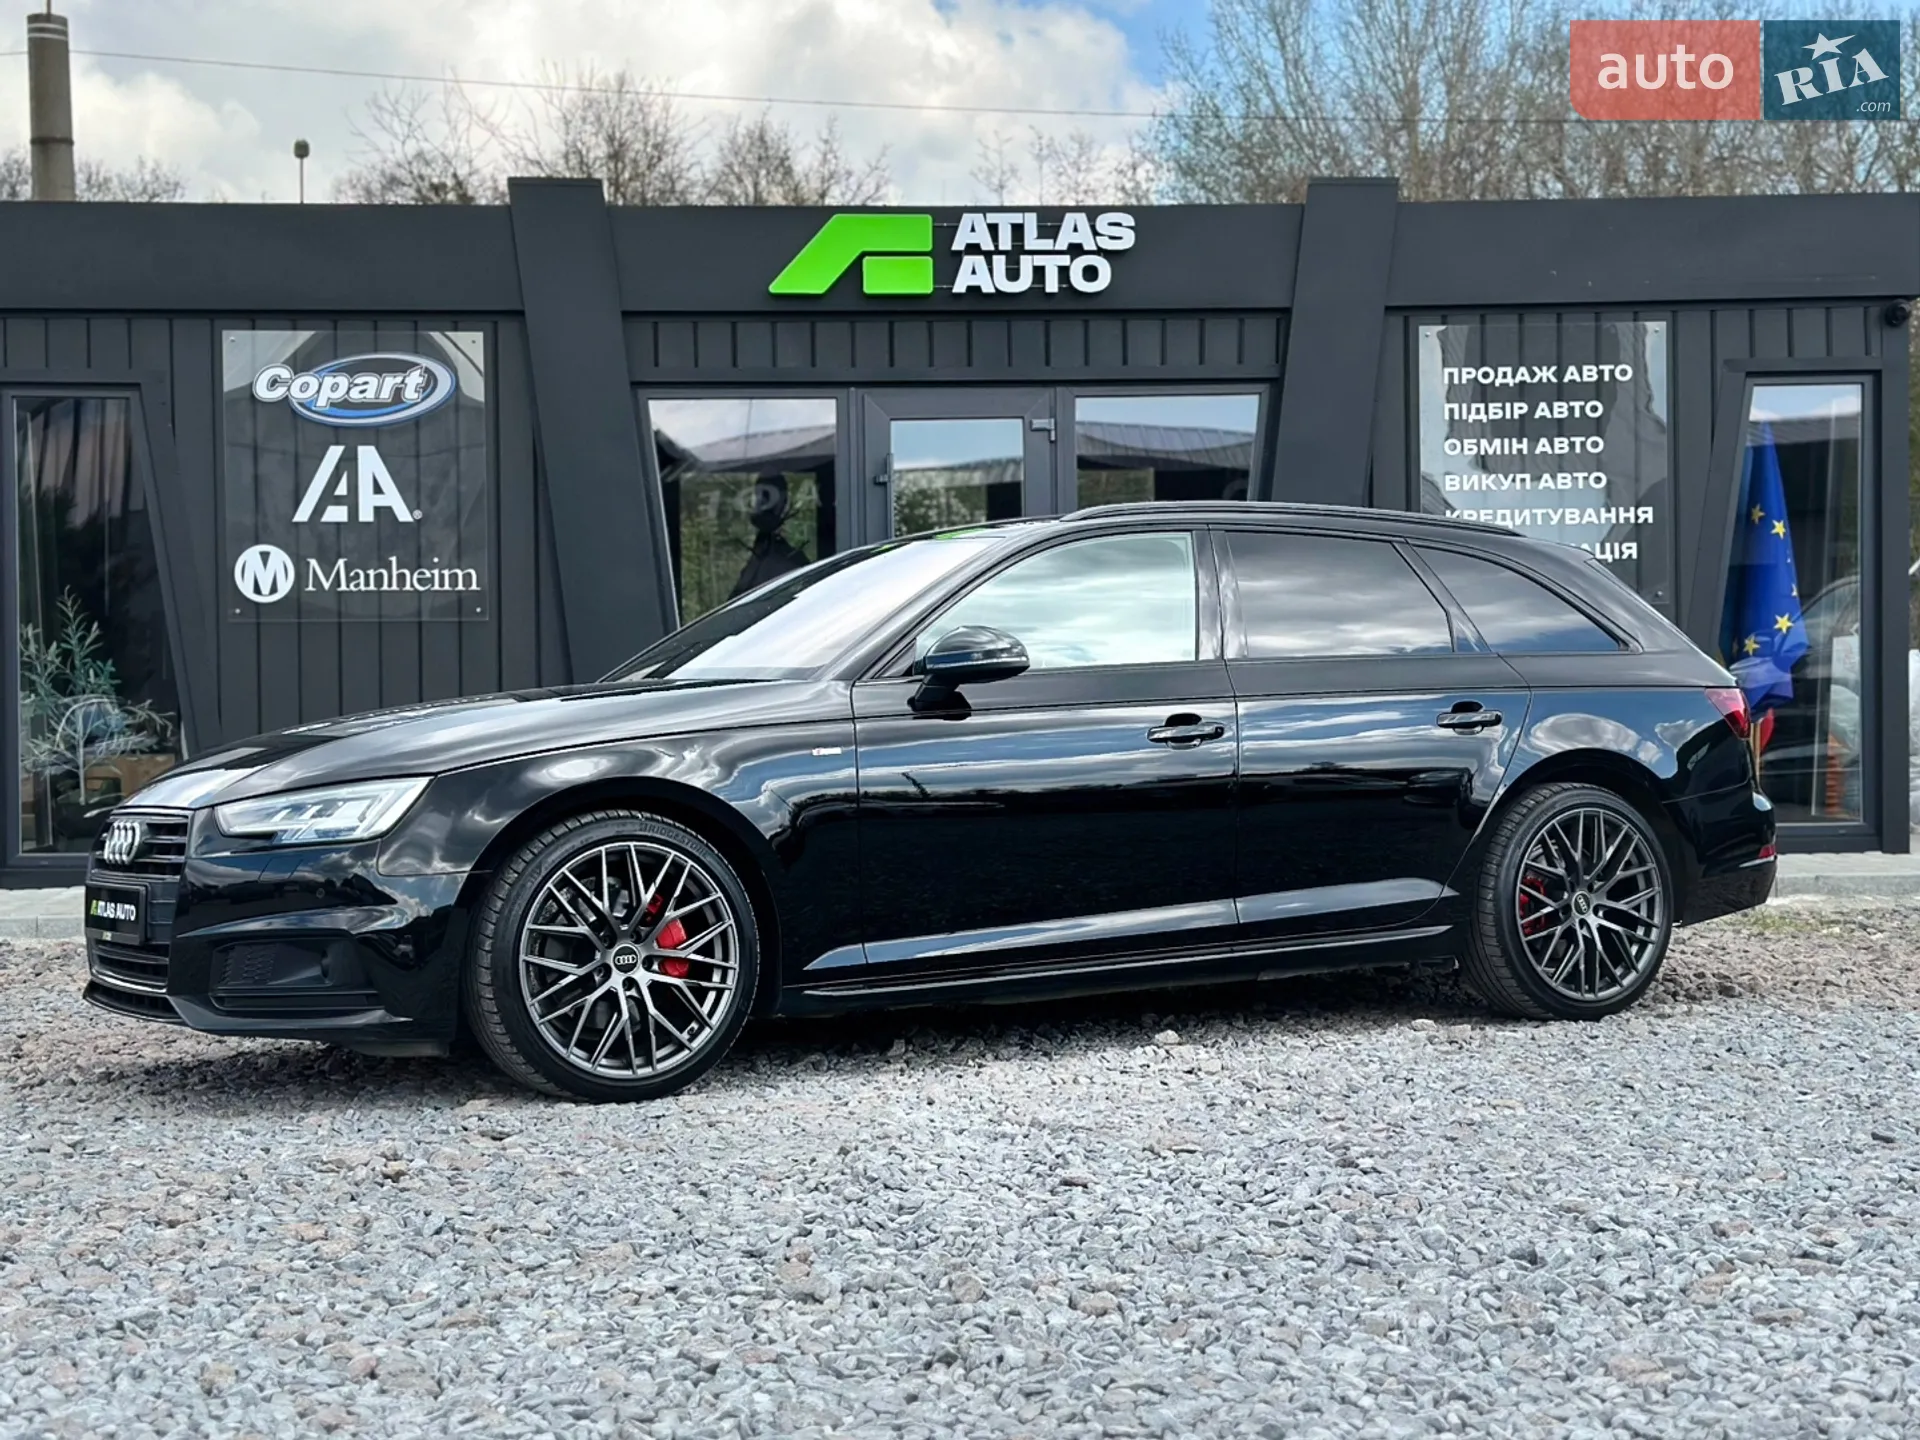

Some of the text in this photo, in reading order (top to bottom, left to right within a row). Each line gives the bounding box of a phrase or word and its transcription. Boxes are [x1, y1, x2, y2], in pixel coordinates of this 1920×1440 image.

[950, 212, 1136, 251] ATLAS
[951, 254, 1112, 295] AUTO
[253, 362, 428, 410] Copart
[1443, 363, 1634, 387] ПРОДАЖ АВТО
[1443, 400, 1604, 424] ПІДБІР АВТО
[1443, 436, 1605, 456] ОБМІН АВТО
[1444, 471, 1608, 492] ВИКУП АВТО
[304, 555, 481, 592] Manheim
[97, 900, 136, 921] ATLAS AUTO
